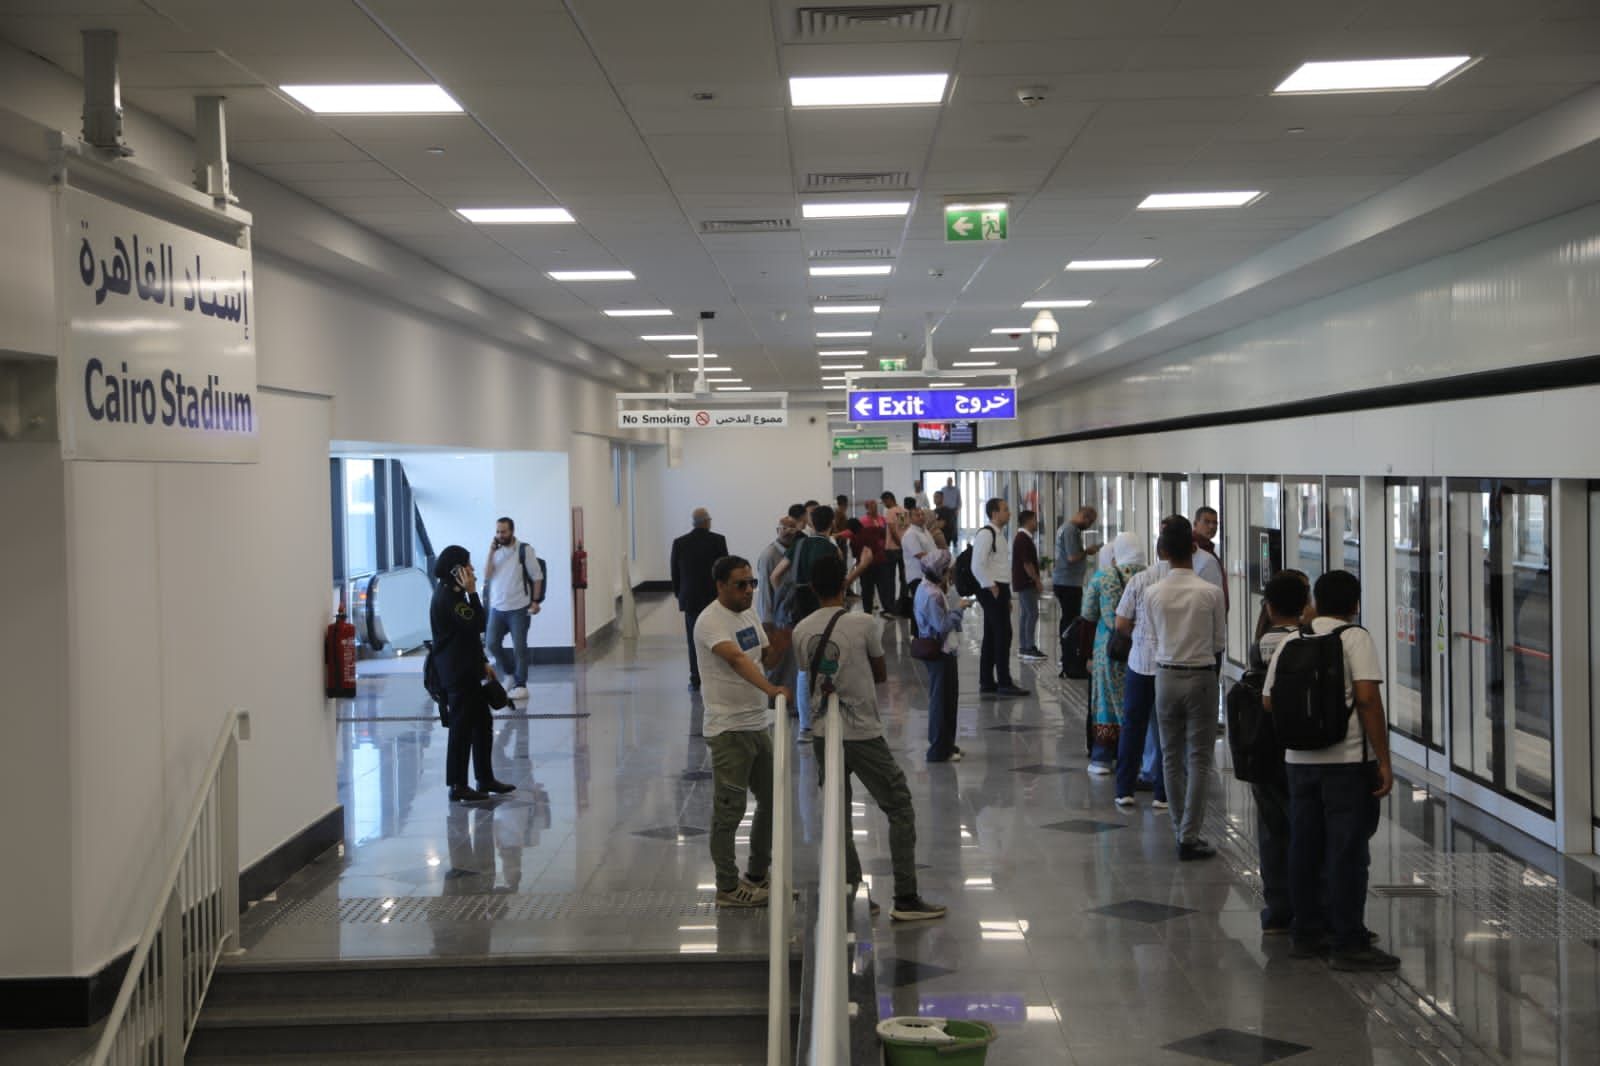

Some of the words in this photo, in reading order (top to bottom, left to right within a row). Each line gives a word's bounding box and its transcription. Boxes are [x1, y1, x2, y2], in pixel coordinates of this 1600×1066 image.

[79, 220, 174, 307] القاهرة
[184, 255, 249, 340] إستاد
[85, 358, 156, 425] Cairo
[161, 368, 252, 432] Stadium
[878, 396, 925, 416] Exit
[955, 392, 1010, 414] خروج
[623, 415, 638, 424] No
[642, 414, 690, 426] Smoking
